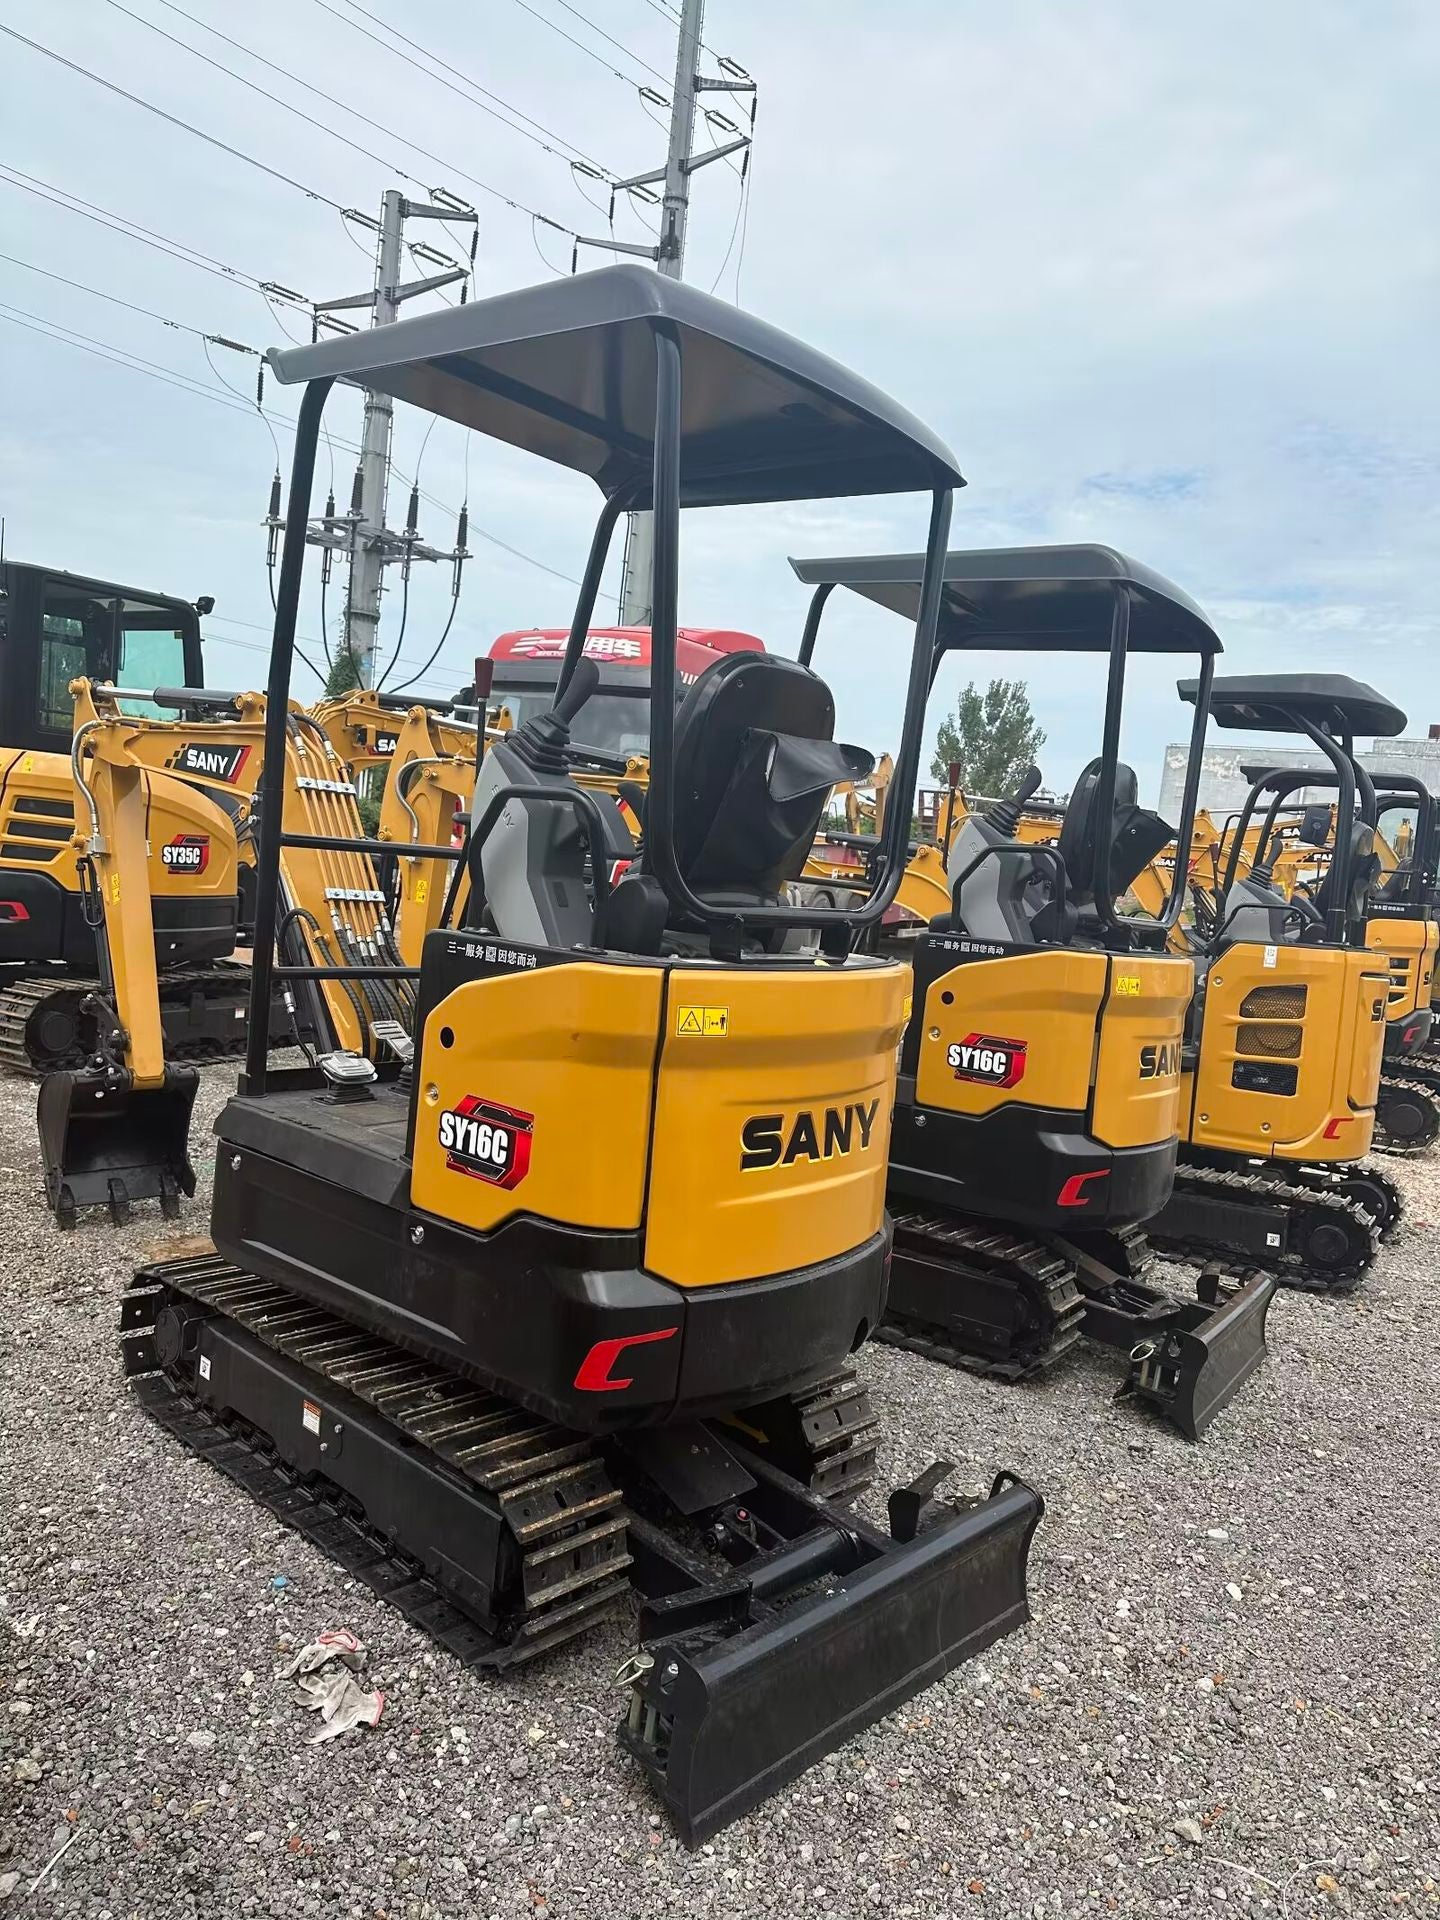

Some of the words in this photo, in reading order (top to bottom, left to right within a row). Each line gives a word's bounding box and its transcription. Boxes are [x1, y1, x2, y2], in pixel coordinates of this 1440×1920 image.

[509, 636, 641, 657] 三一用车
[186, 748, 229, 774] SANY
[163, 846, 201, 864] SY35C
[447, 941, 484, 959] 三一服务
[498, 949, 536, 968] 因您而动
[948, 1044, 1007, 1074] SY16C
[1139, 1044, 1181, 1080] SAN
[440, 1111, 509, 1165] SY16C
[740, 1097, 881, 1173] SANY
